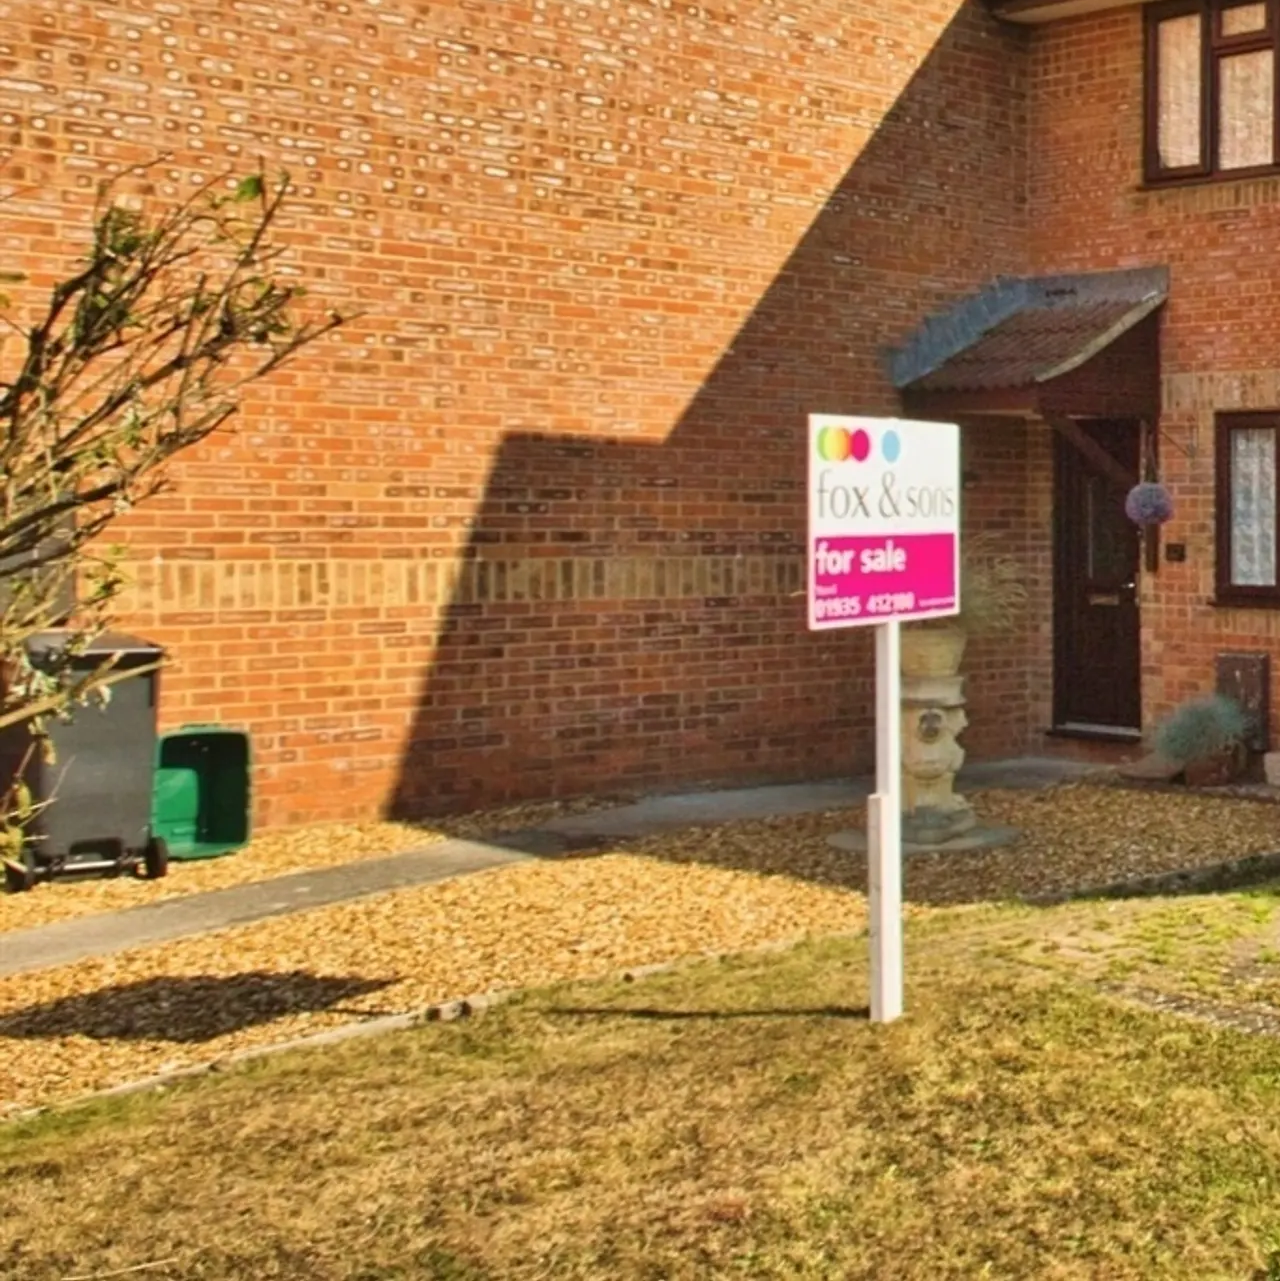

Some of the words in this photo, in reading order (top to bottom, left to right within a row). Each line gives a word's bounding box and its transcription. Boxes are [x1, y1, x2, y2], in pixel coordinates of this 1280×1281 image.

[817, 468, 870, 520] fox
[878, 470, 901, 519] &
[906, 485, 956, 518] sons
[815, 540, 855, 576] for
[860, 539, 907, 574] sale
